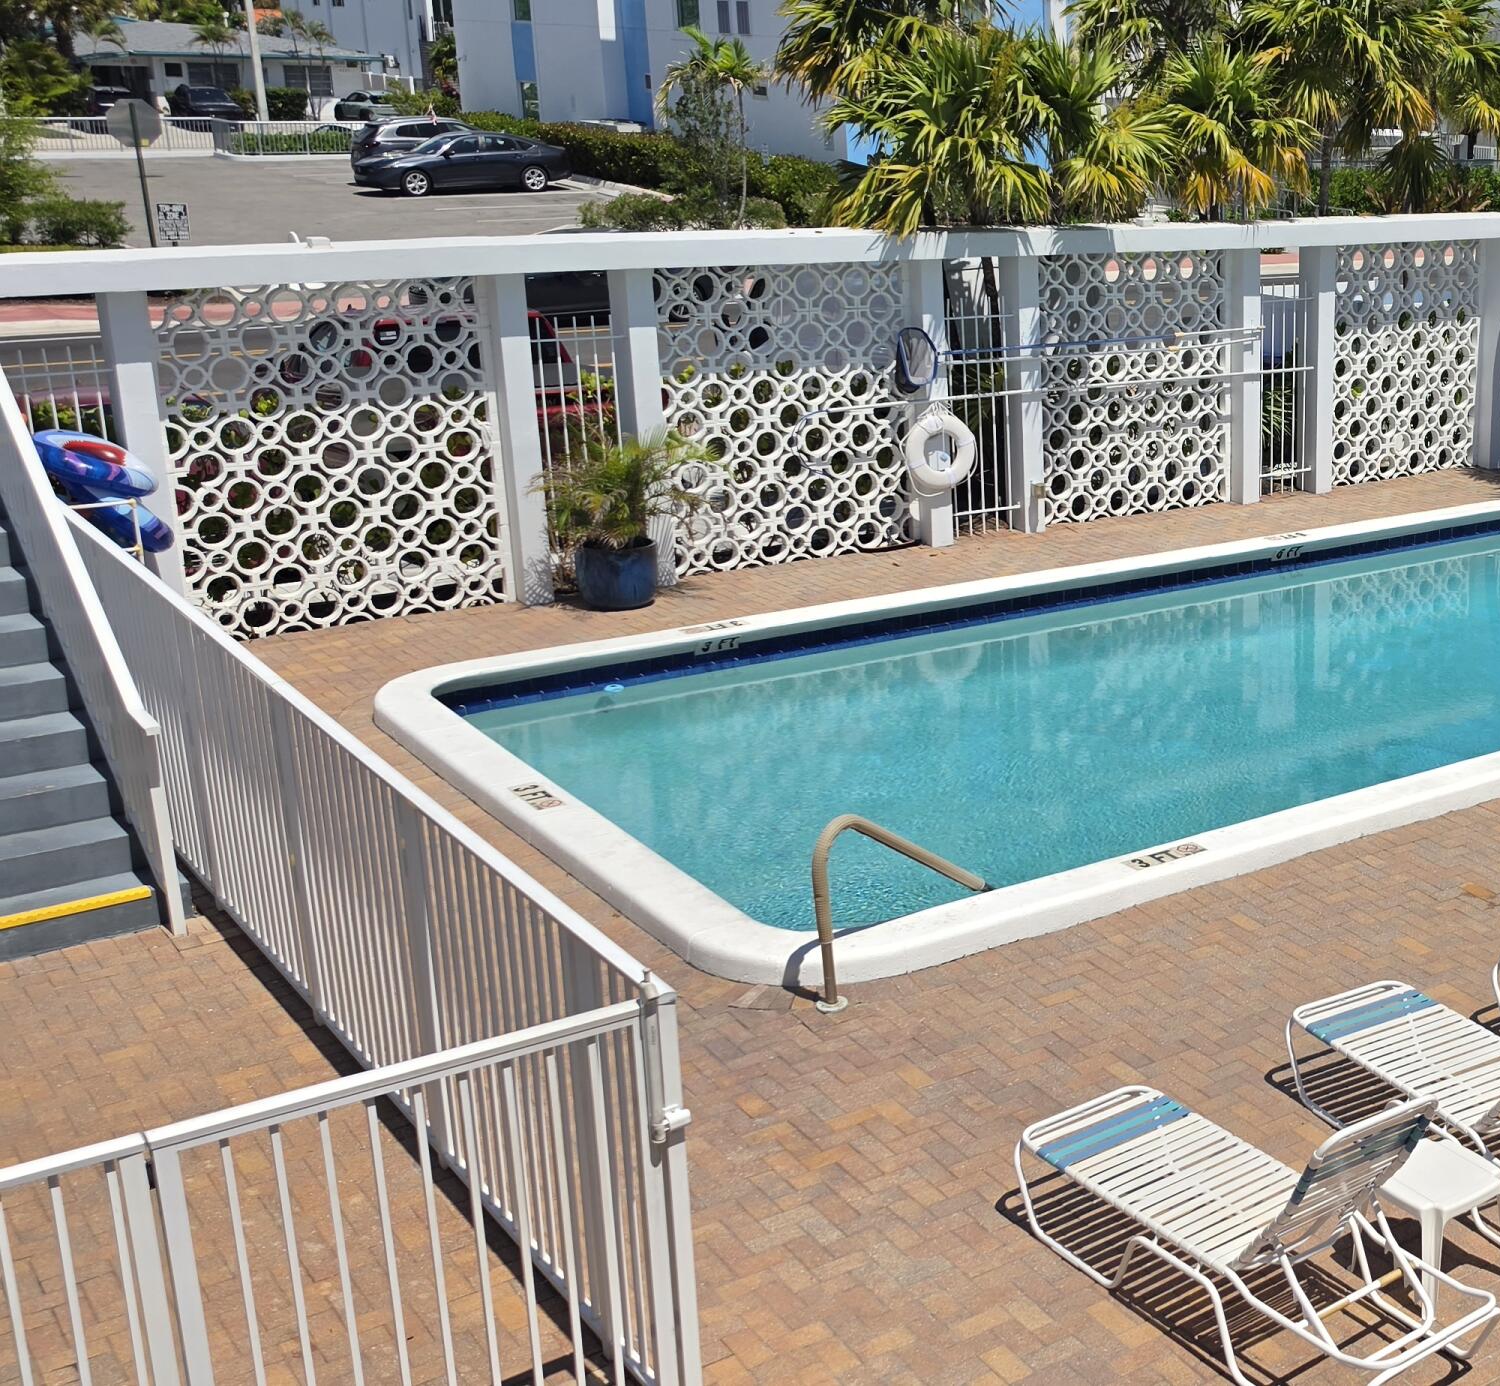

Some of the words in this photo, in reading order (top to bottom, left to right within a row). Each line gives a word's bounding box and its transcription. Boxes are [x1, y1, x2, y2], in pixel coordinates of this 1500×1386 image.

[1287, 545, 1304, 558] FT
[701, 641, 713, 652] 3
[718, 636, 741, 650] FT
[513, 784, 539, 792] 3
[519, 790, 553, 802] FT
[1131, 858, 1151, 868] 3
[1147, 849, 1180, 863] FT
